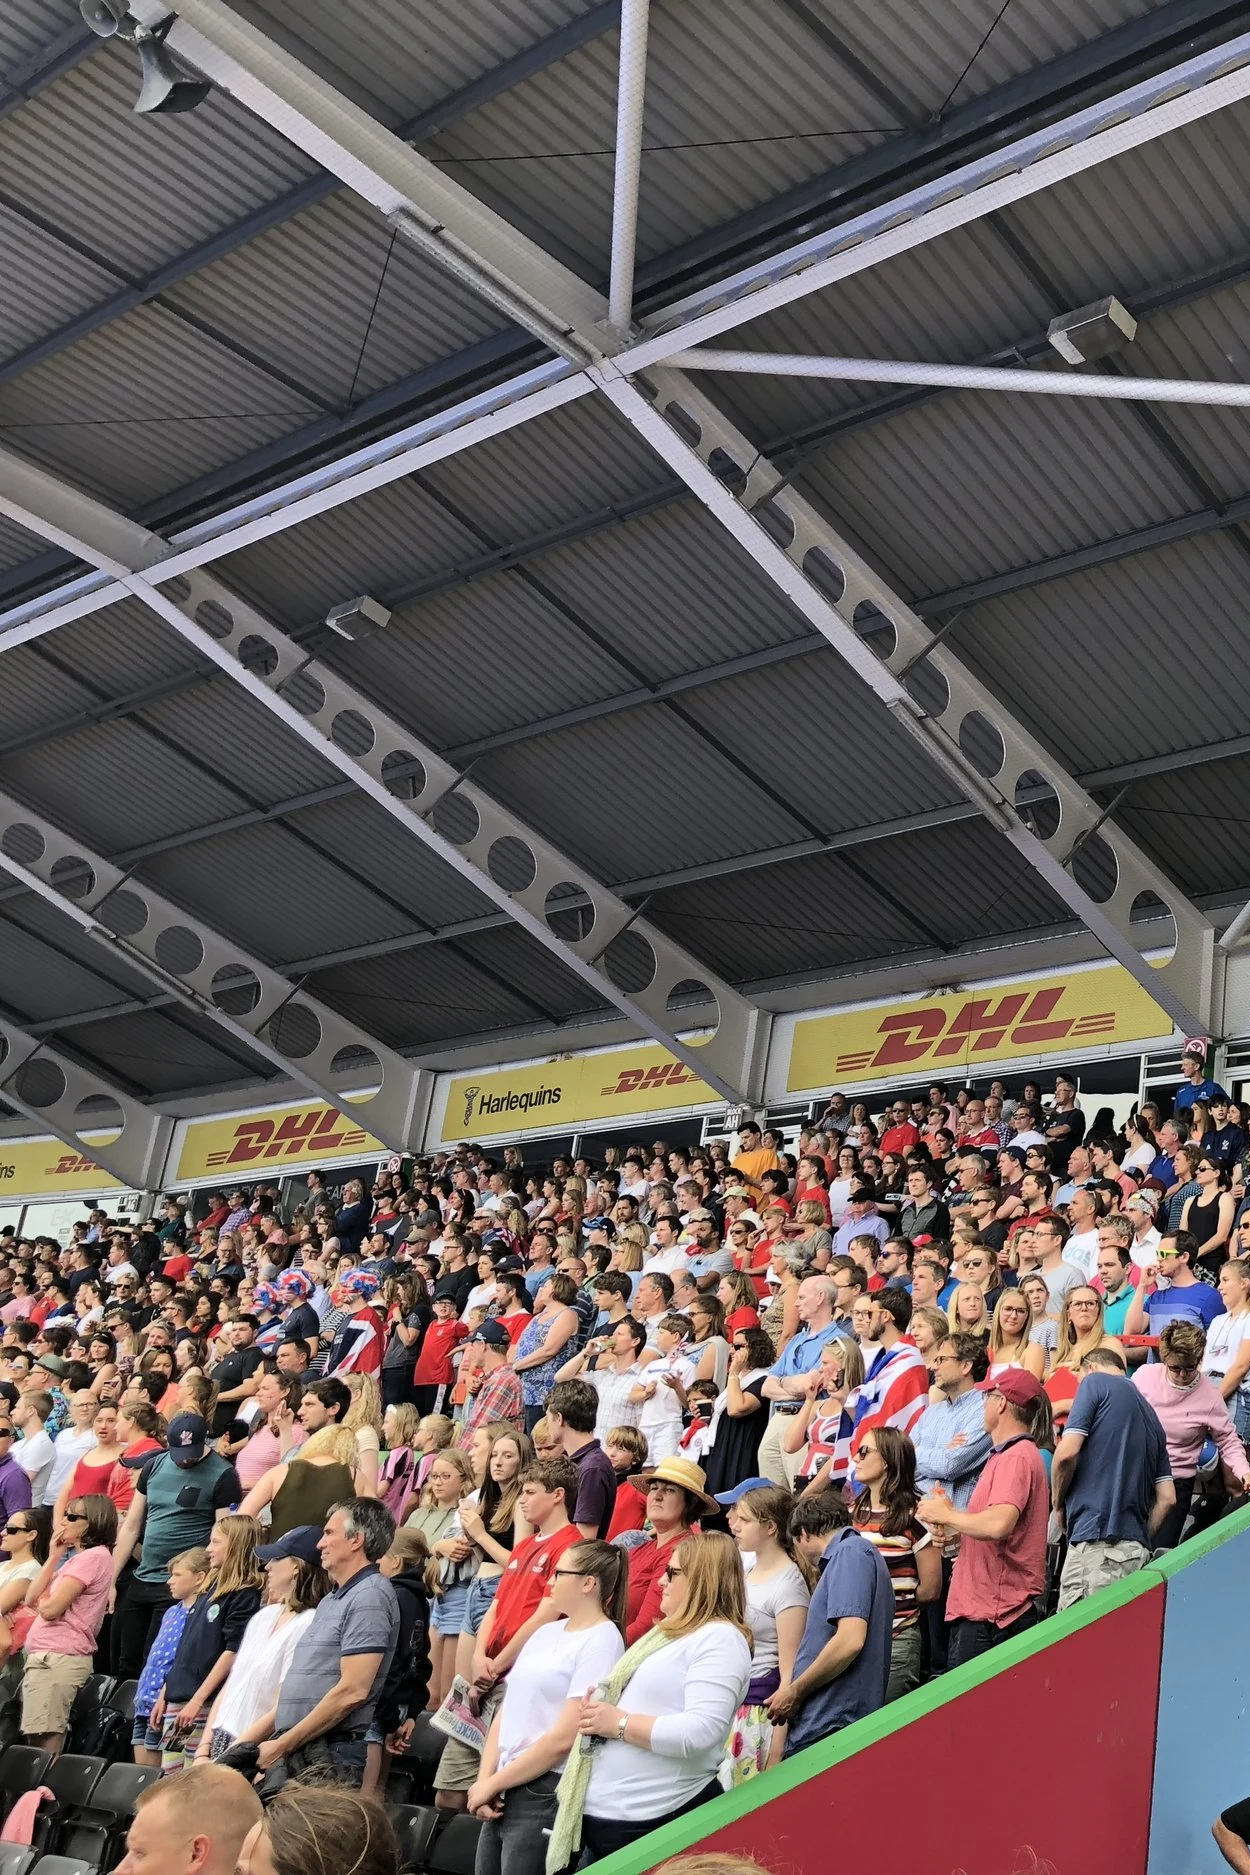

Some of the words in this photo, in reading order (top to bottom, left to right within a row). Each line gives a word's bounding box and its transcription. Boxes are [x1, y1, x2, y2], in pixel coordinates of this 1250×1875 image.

[871, 986, 1078, 1068] DHL
[614, 1062, 691, 1094] DHL
[479, 1085, 562, 1115] Harlequins
[726, 1107, 742, 1116] BLOCK
[226, 1108, 346, 1164] DHL
[725, 1115, 740, 1129] AH
